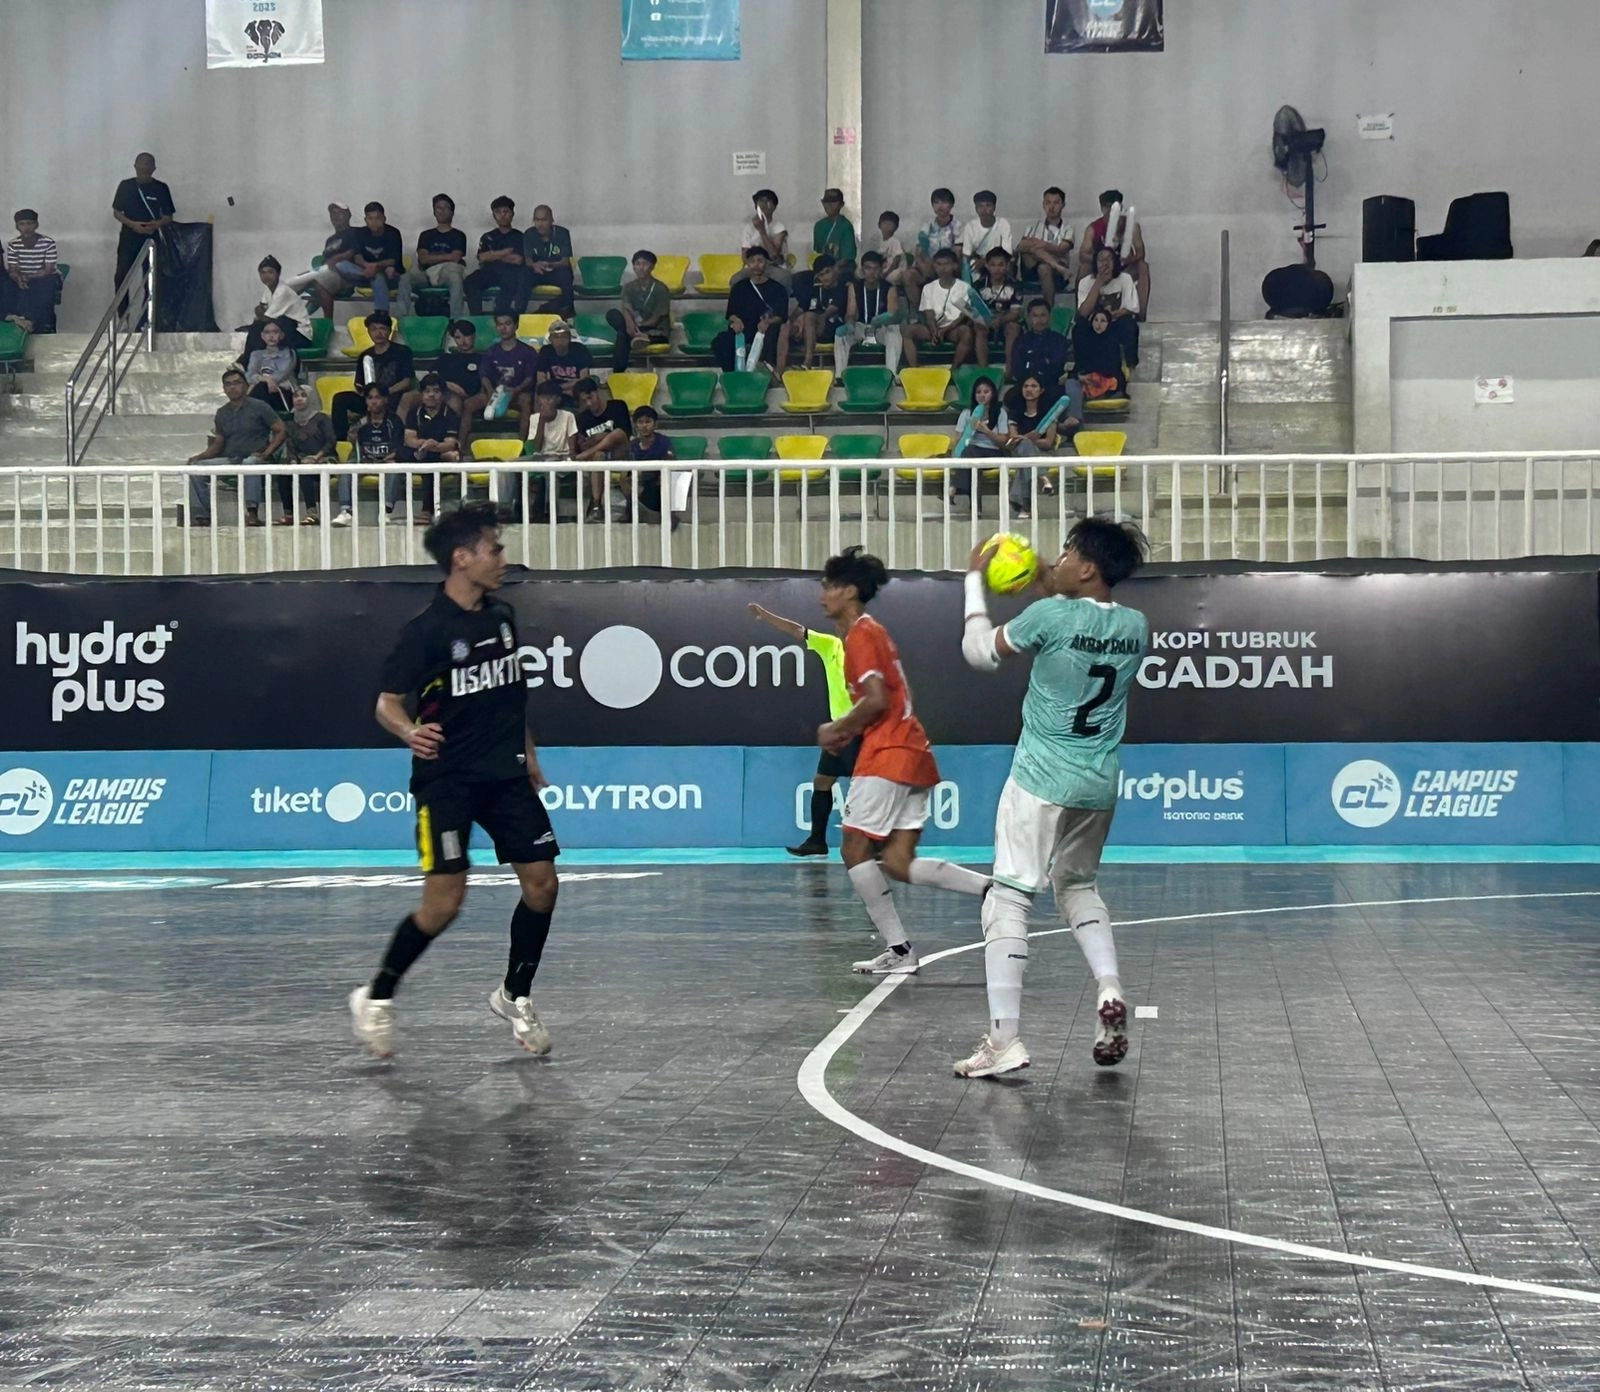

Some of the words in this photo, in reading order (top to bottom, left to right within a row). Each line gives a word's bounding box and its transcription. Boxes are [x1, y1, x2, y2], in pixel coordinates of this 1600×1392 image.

[1152, 631, 1210, 650] KOPI
[1216, 631, 1317, 649] TUBRUK
[451, 652, 520, 697] USAKTI
[1136, 655, 1334, 689] GADJAH
[51, 669, 166, 722] plus
[1071, 664, 1117, 735] 2
[63, 777, 168, 801] CAMPUS
[1117, 769, 1245, 809] roplus
[1412, 769, 1519, 793] CAMPUS
[538, 784, 703, 811] OLYTRON
[1339, 785, 1389, 809] CL
[1403, 794, 1503, 818] LEAGUE
[53, 801, 150, 825] LEAGUE
[1163, 811, 1211, 821] ISOTONIC
[1213, 811, 1244, 821] DRINK
